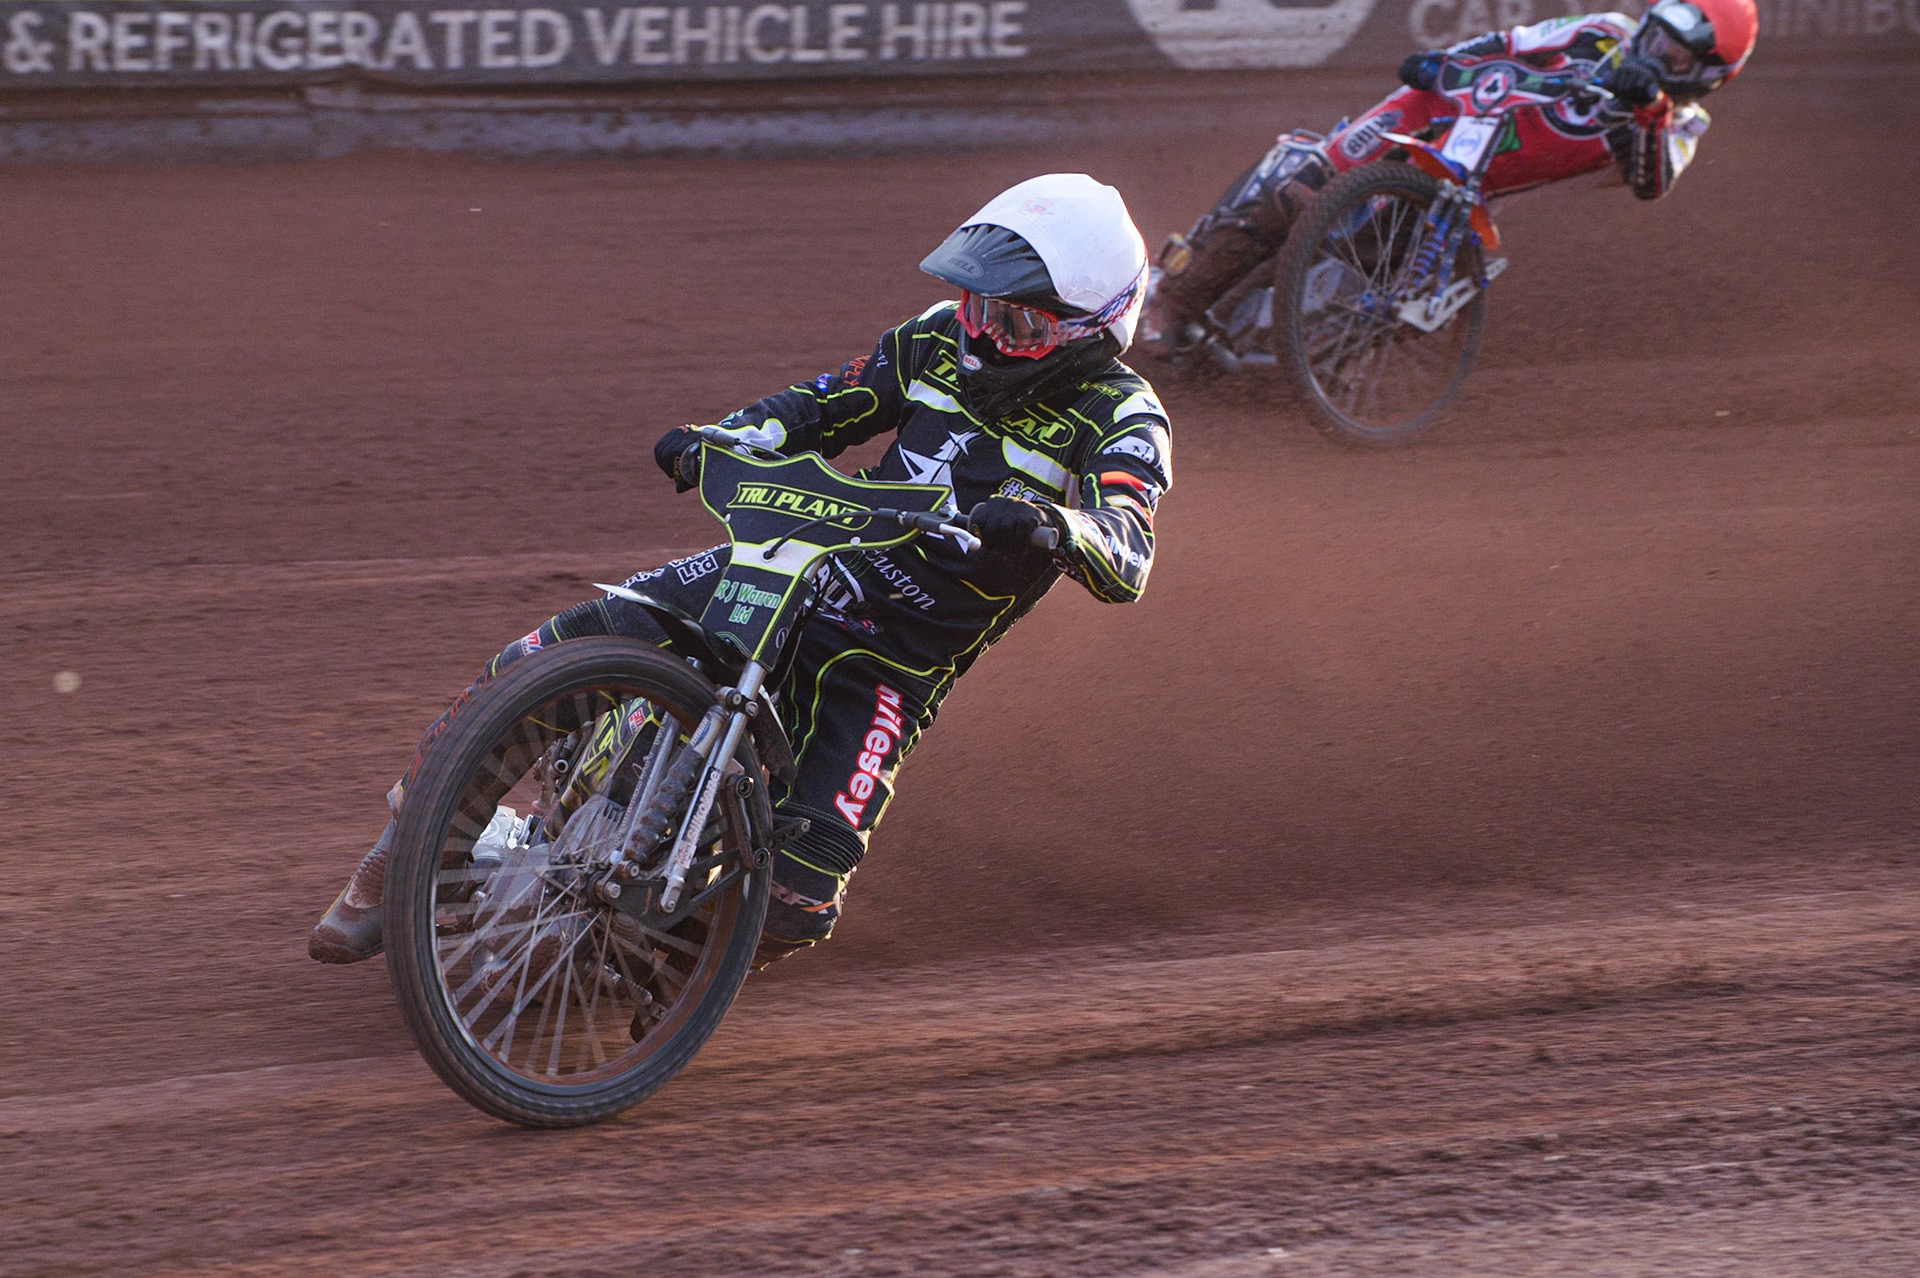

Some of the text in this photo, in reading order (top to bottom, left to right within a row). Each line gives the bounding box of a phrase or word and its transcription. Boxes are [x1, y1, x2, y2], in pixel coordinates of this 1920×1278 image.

[4, 2, 1029, 73] & REFRIGERATED VEHICLE HIRE
[962, 355, 980, 367] BELL
[737, 486, 858, 525] TRU PLANT
[676, 554, 719, 586] Ltd
[714, 579, 782, 610] R J Warren
[728, 604, 755, 625] Ltd
